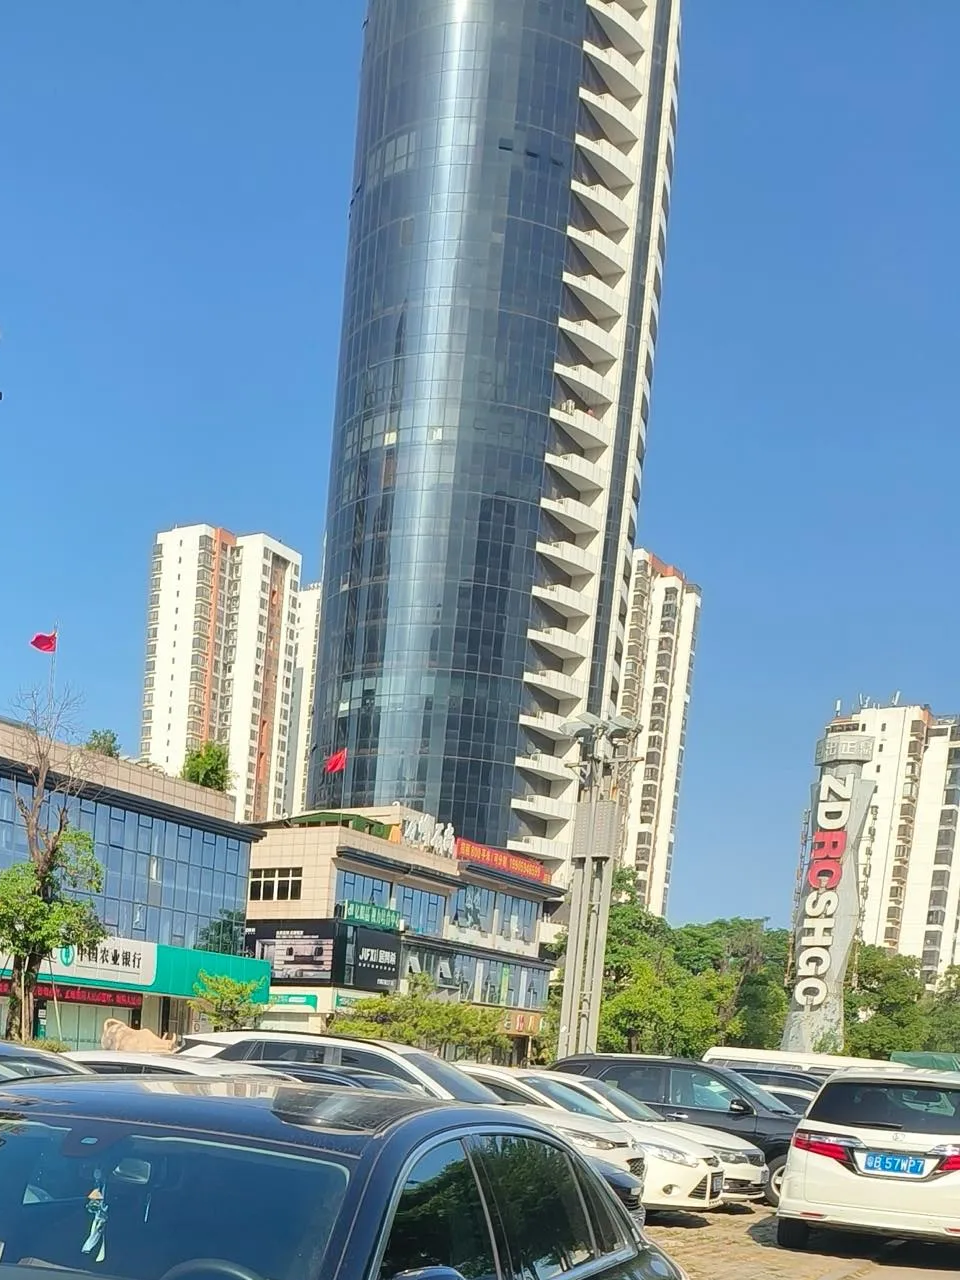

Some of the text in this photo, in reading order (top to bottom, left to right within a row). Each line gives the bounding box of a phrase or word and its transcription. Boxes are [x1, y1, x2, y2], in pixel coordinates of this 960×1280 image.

[77, 943, 142, 969] 中国农业银行
